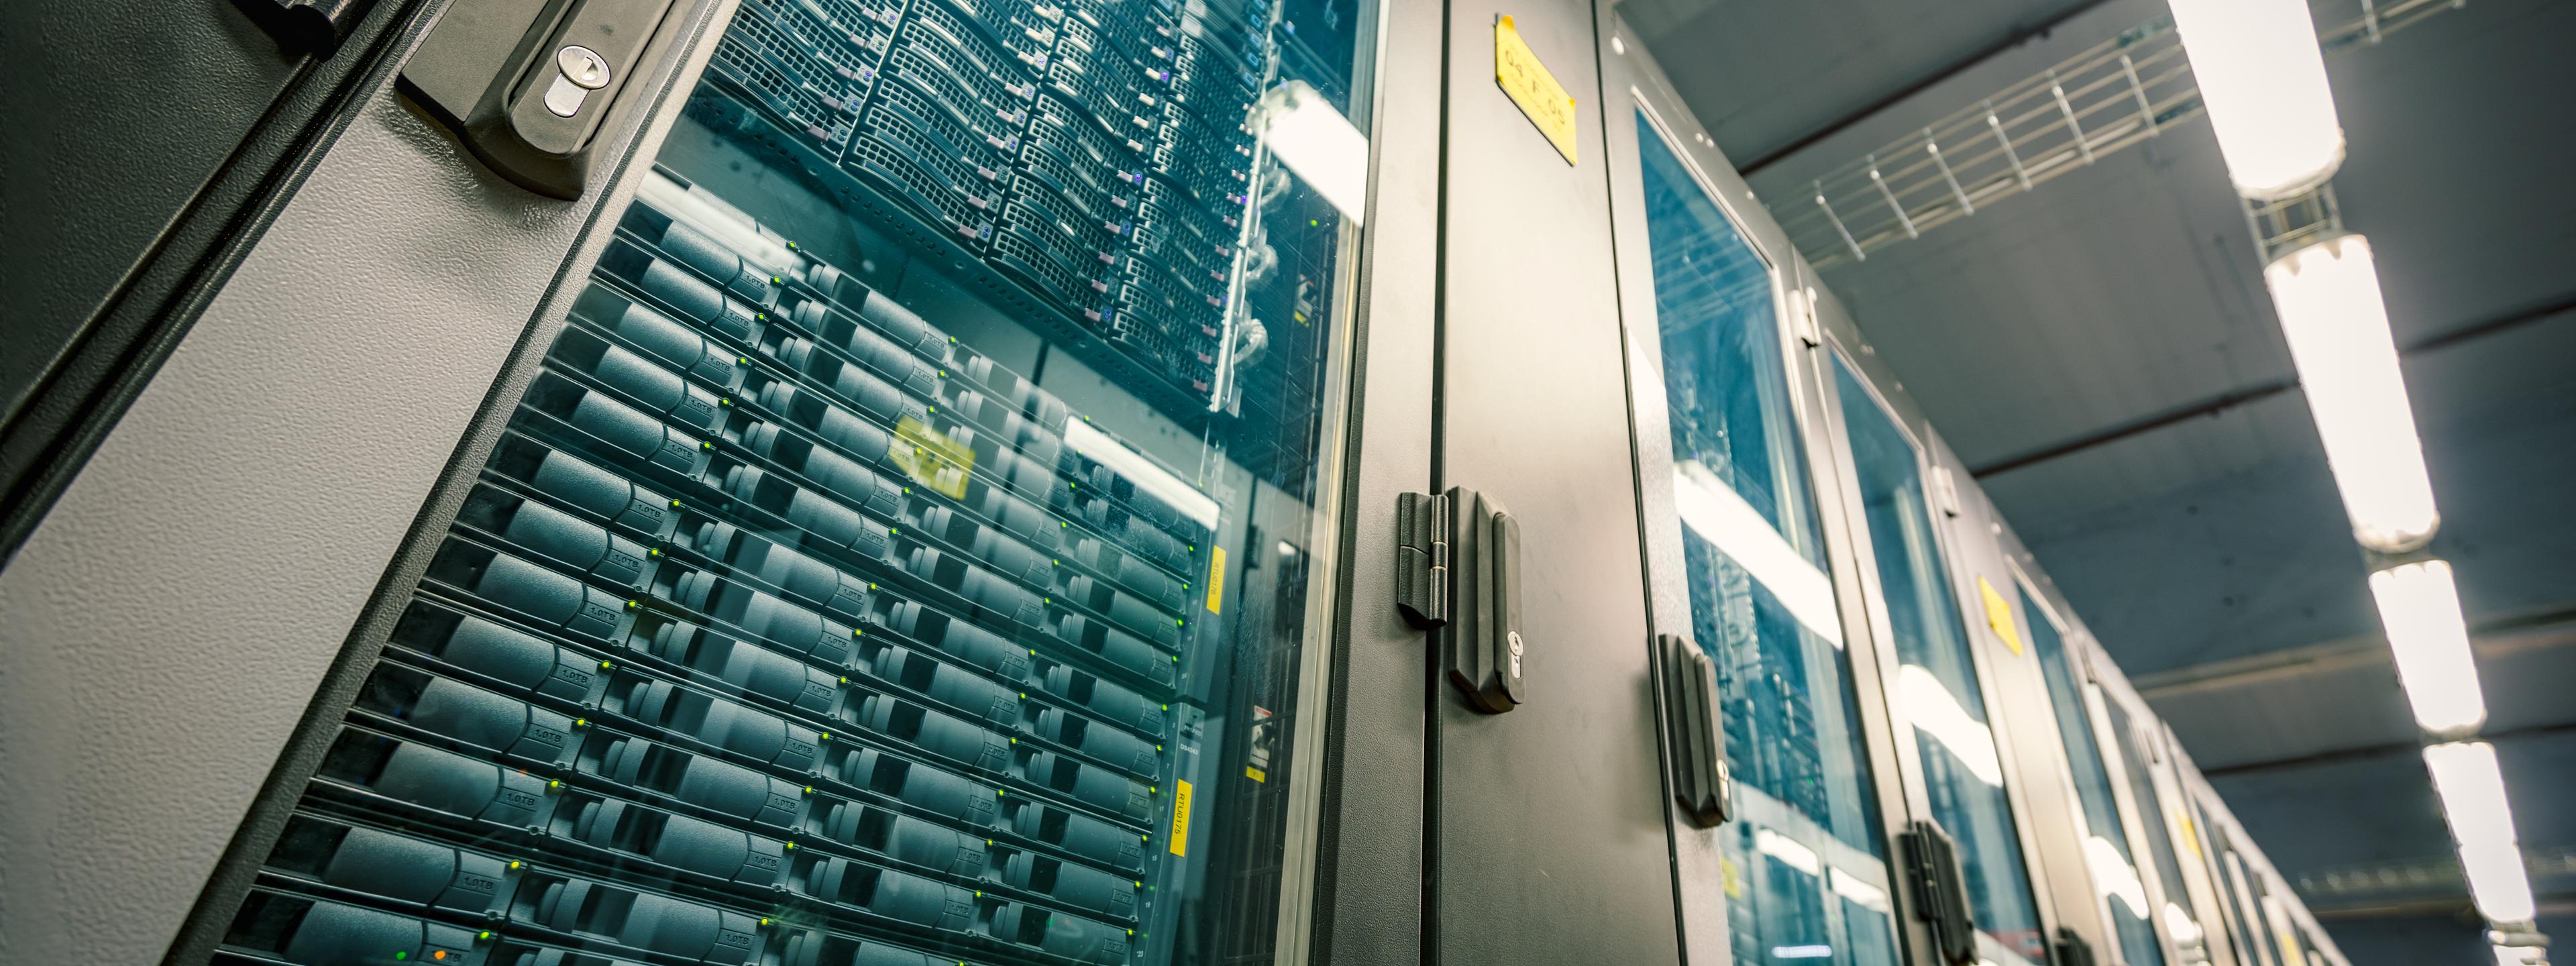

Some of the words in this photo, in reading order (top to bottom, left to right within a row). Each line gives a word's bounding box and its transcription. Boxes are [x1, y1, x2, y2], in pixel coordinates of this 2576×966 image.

[1505, 50, 1524, 78] 04
[1532, 80, 1540, 93] F
[1548, 99, 1566, 125] 05
[746, 275, 765, 289] 1.0TB
[729, 312, 749, 326] 1.0TB
[710, 358, 731, 372] 1.0TB
[918, 371, 934, 383] 1.0TB
[691, 399, 712, 413] 1.0TB
[906, 407, 924, 420] 1.0TB
[672, 443, 693, 458] 1.0TB
[638, 504, 661, 518] 1.0TB
[614, 554, 639, 568] 1.0TB
[591, 606, 615, 621] 1.0TB
[563, 669, 588, 684] 1.0TB
[811, 685, 831, 697] 1.0TB
[535, 729, 561, 743] 1.0TB
[791, 742, 812, 754] 1.0TB
[506, 793, 535, 806] 1.0TB
[1175, 793, 1185, 835] RTU0175
[464, 877, 494, 890] 1.0TB
